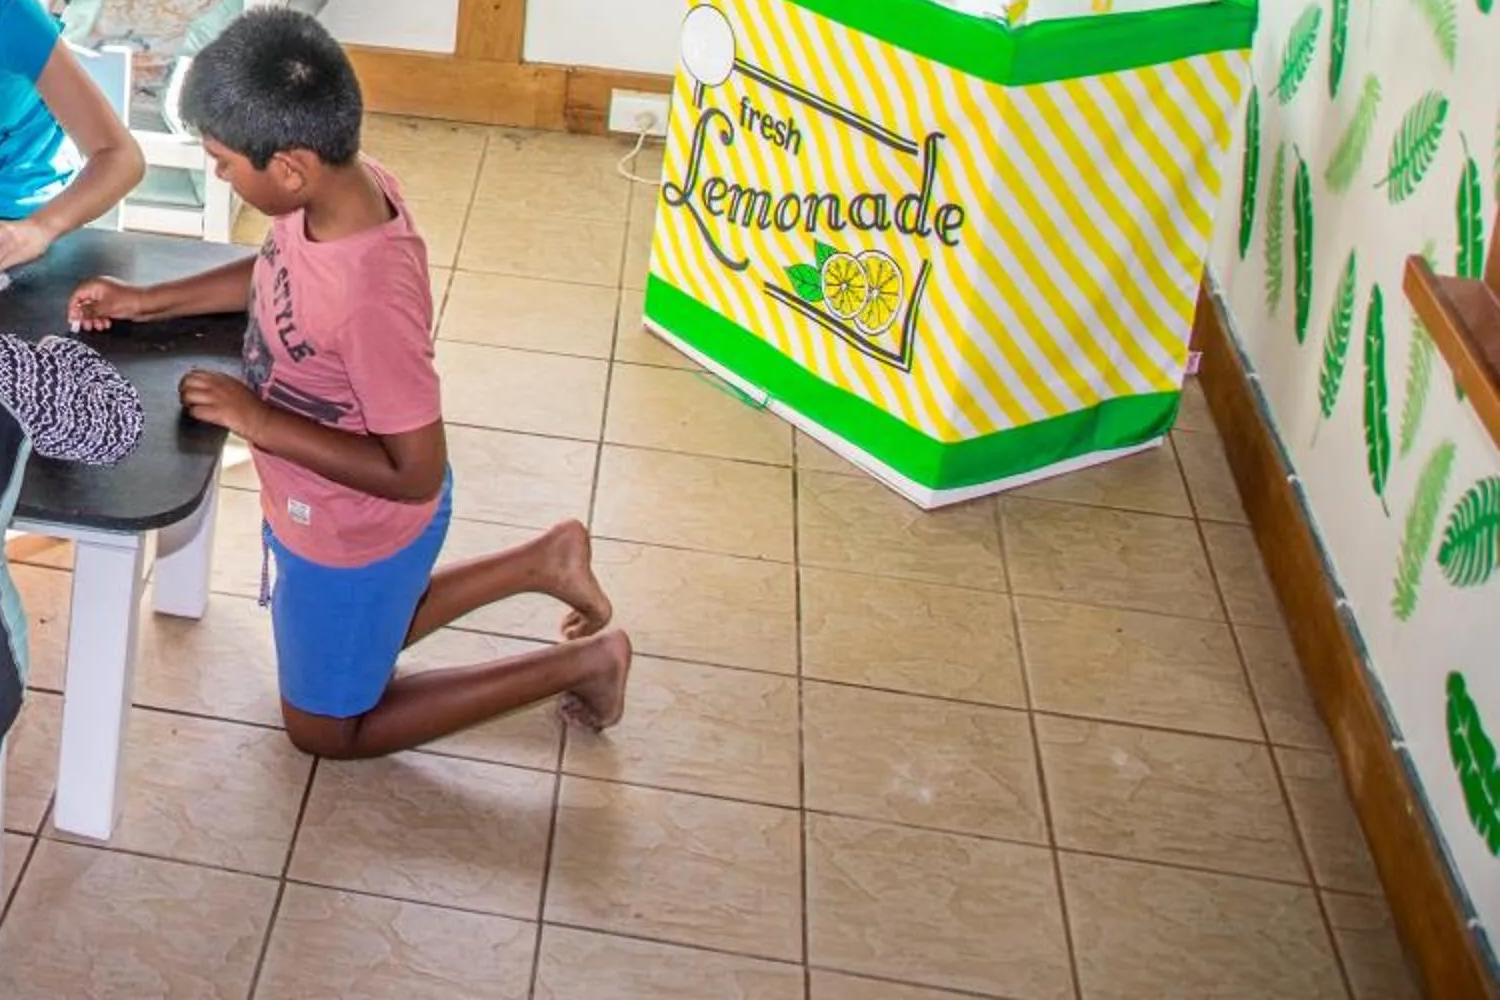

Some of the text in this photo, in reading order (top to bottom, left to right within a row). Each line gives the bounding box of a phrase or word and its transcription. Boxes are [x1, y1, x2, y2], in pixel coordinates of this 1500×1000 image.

[739, 95, 802, 156] fresh
[661, 107, 965, 272] Lemonade
[273, 266, 317, 363] STYLE
